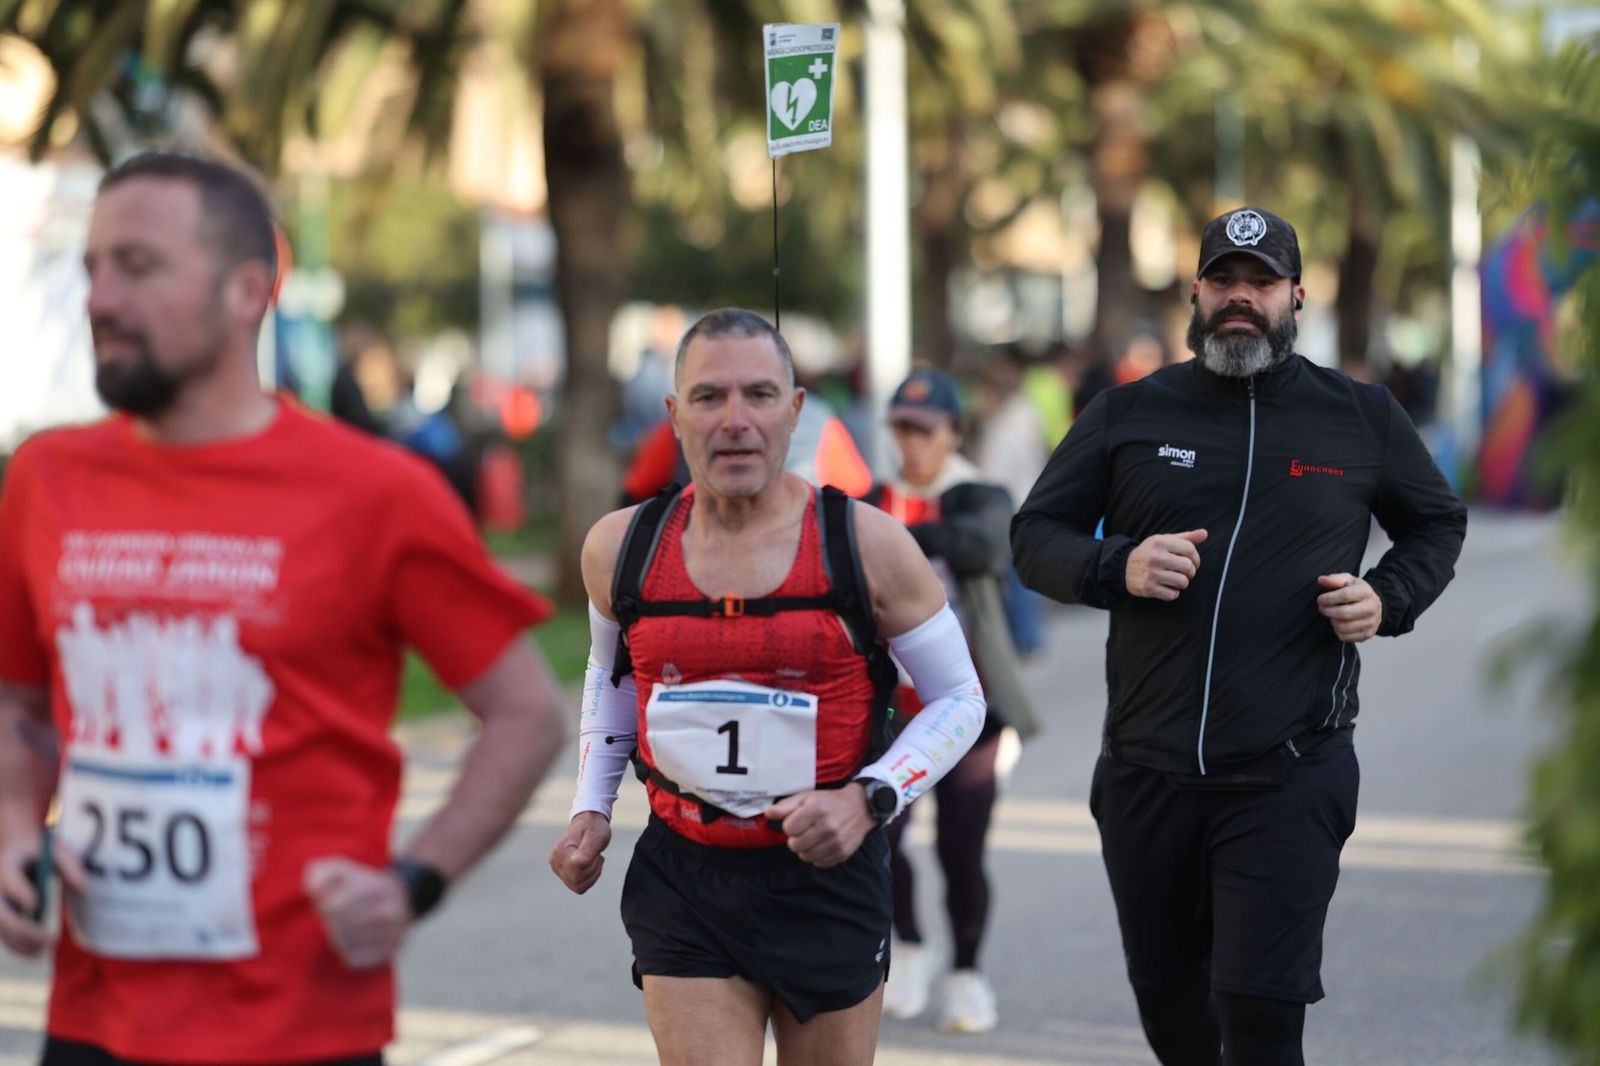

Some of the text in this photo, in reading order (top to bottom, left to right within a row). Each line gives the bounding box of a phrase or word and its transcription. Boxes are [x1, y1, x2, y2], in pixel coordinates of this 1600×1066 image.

[808, 119, 829, 132] DEA
[1158, 443, 1196, 460] simon
[716, 720, 748, 775] 1
[82, 802, 211, 886] 250
